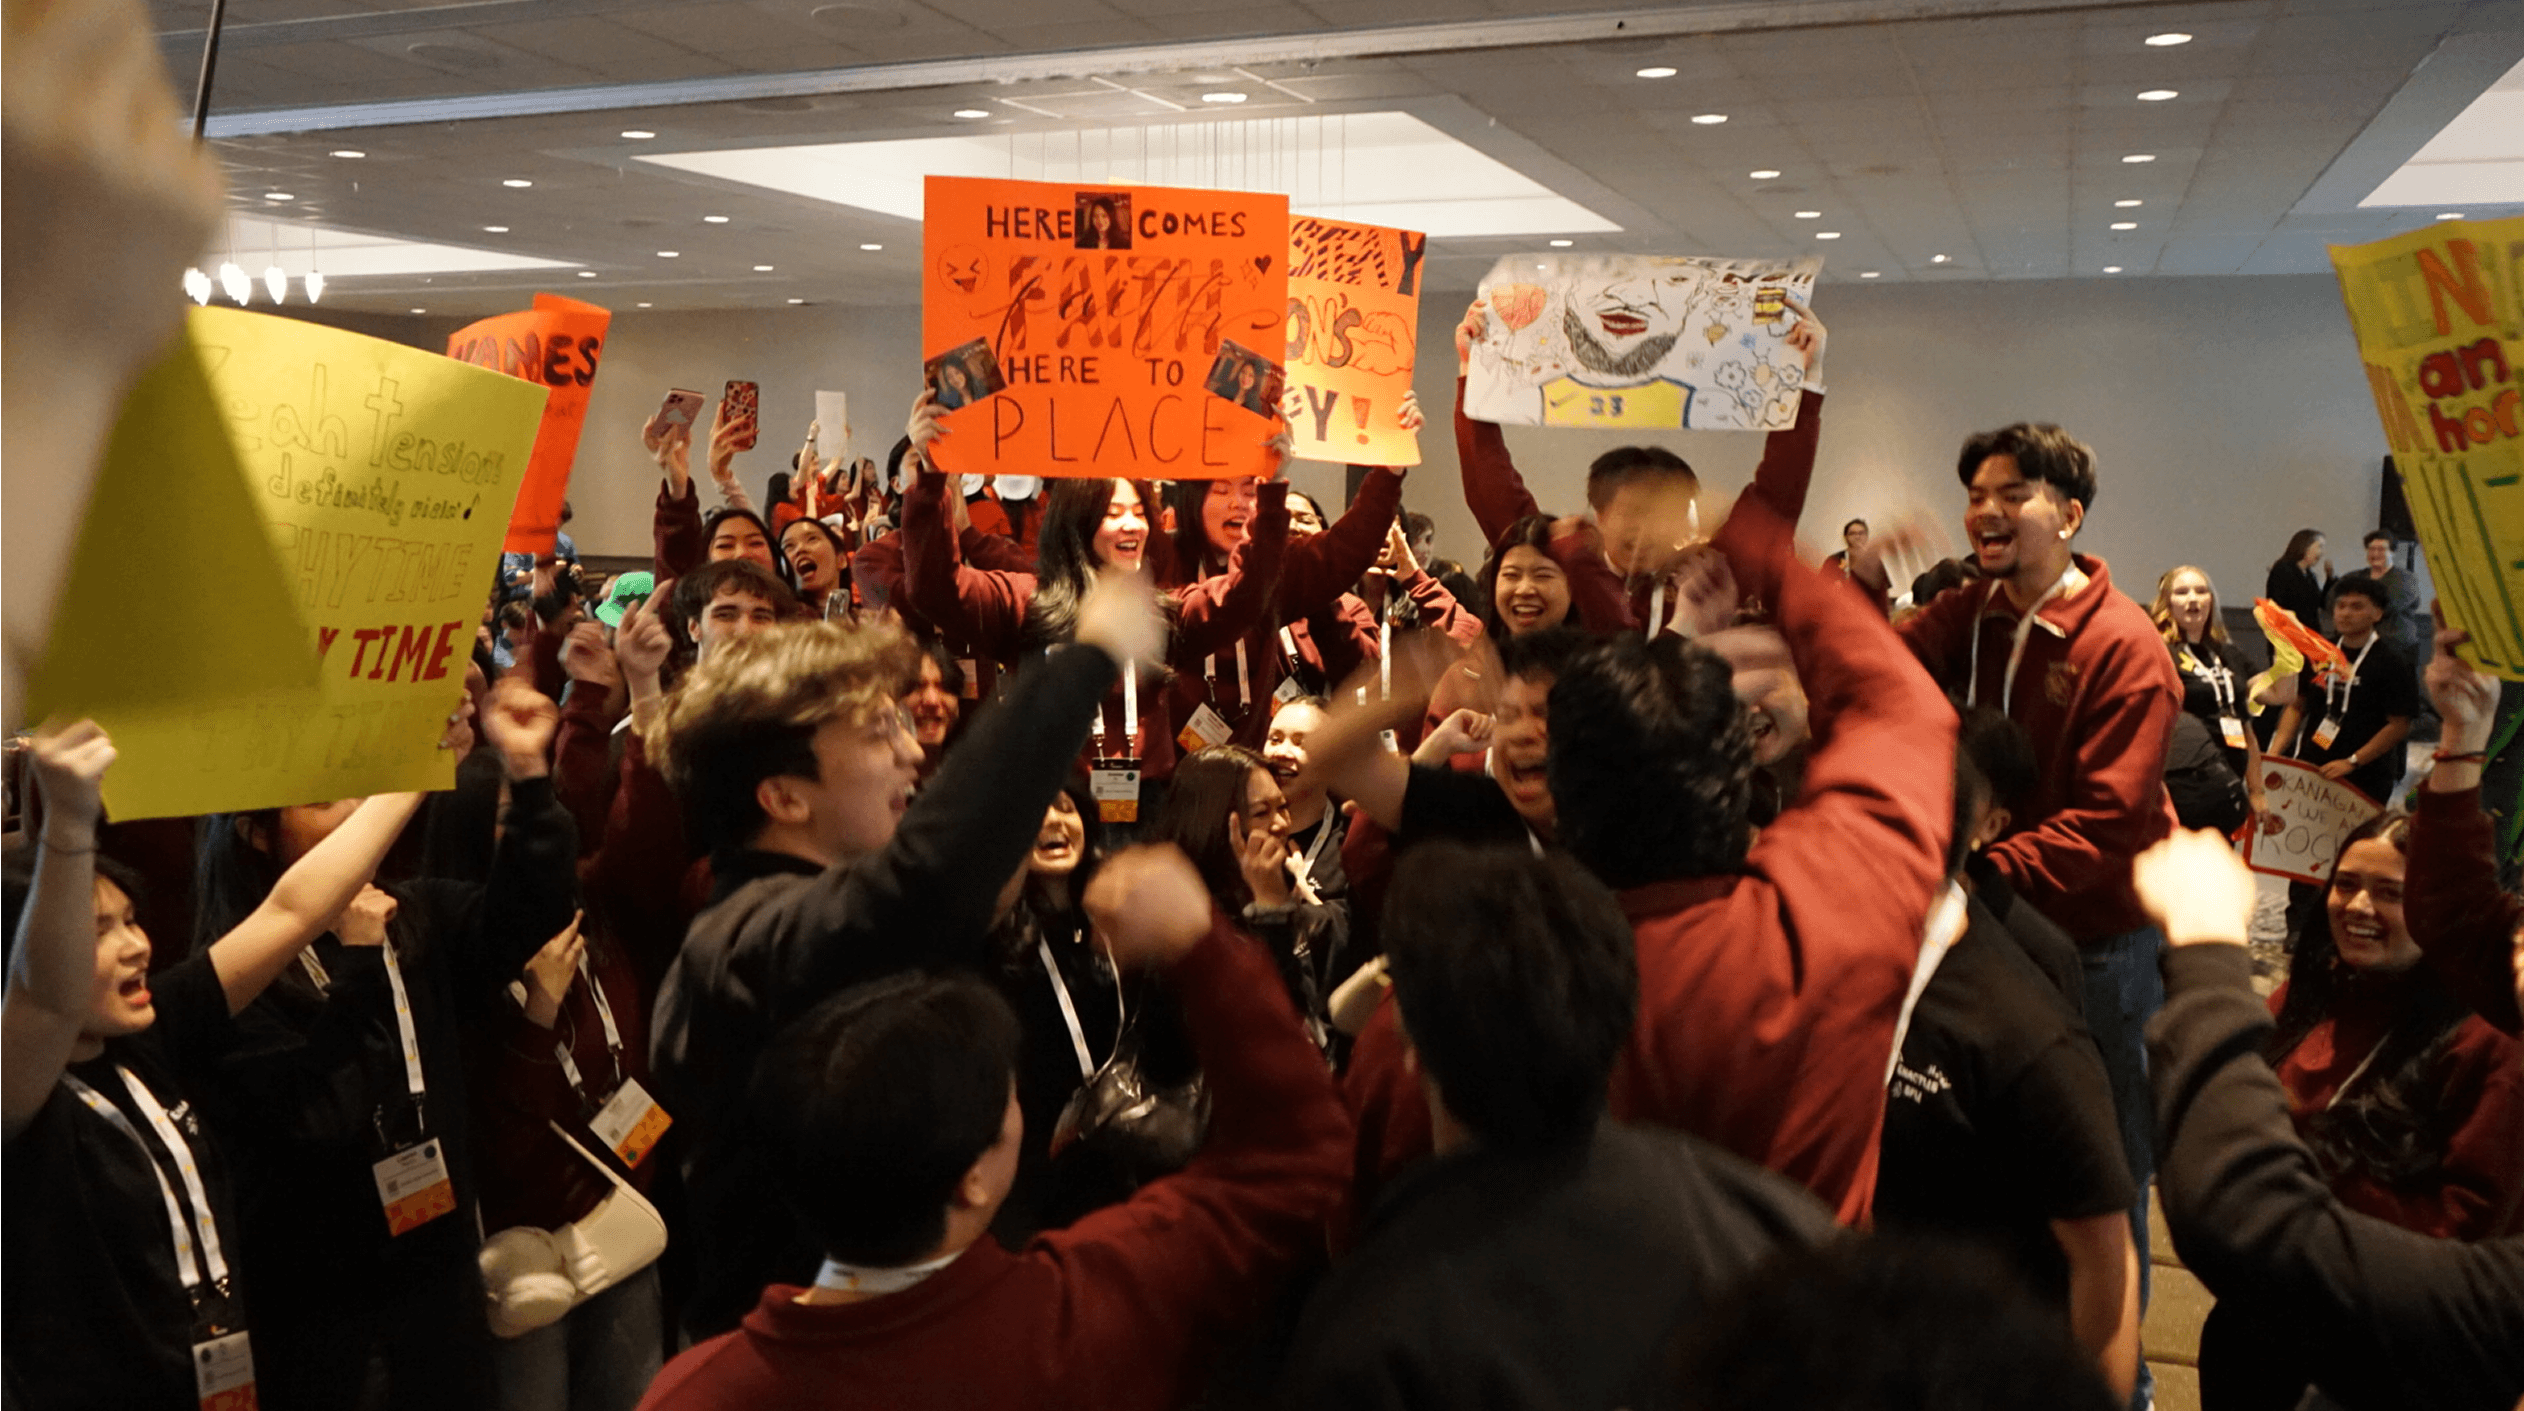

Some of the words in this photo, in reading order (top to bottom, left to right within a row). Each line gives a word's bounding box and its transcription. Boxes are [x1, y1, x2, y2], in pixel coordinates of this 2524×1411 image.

[986, 205, 1074, 241] HERE
[1138, 208, 1248, 240] COMES
[1008, 254, 1225, 356] FAITH
[452, 331, 600, 388] ANES
[1008, 355, 1101, 385] HERE
[1144, 357, 1185, 387] TO
[2418, 336, 2512, 400] an
[993, 393, 1230, 467] PLACE
[350, 620, 464, 684] TIME
